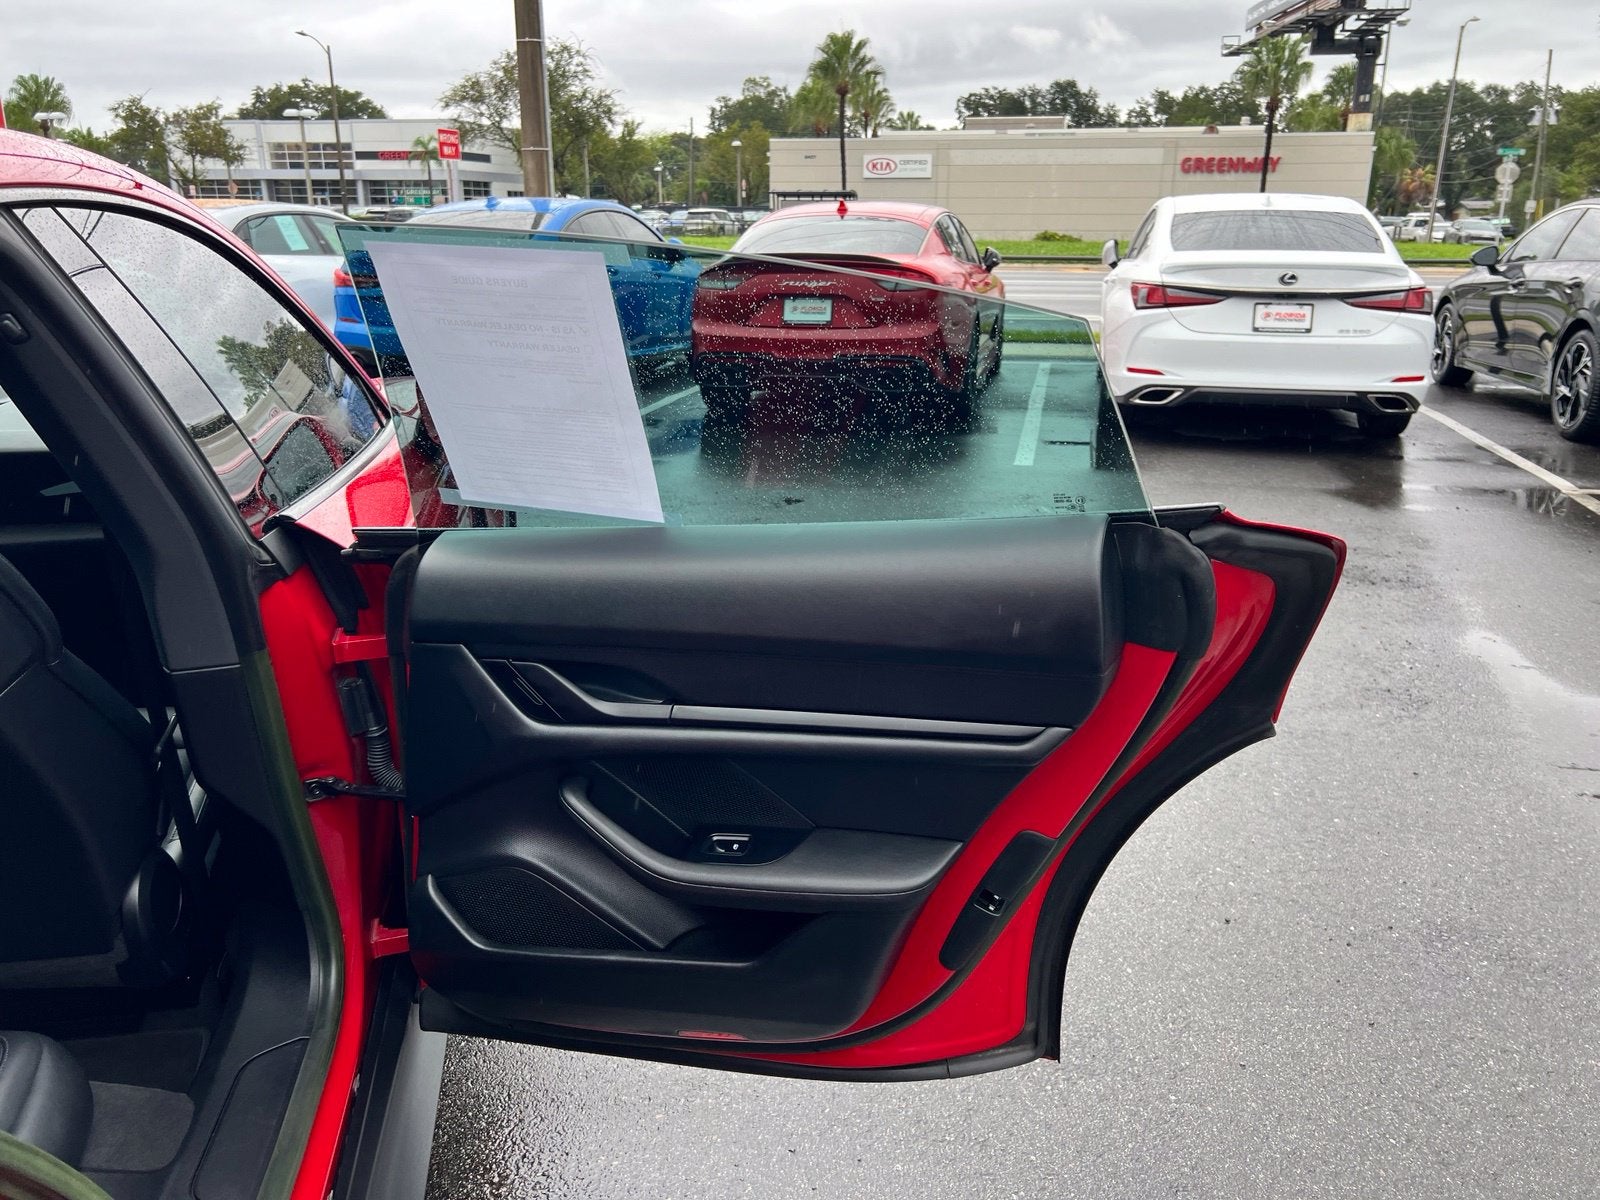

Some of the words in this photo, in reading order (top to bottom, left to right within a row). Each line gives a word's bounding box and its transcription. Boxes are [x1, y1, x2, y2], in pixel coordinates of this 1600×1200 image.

[439, 133, 459, 144] WRONG
[443, 145, 456, 155] WAY
[871, 162, 892, 171] KIA
